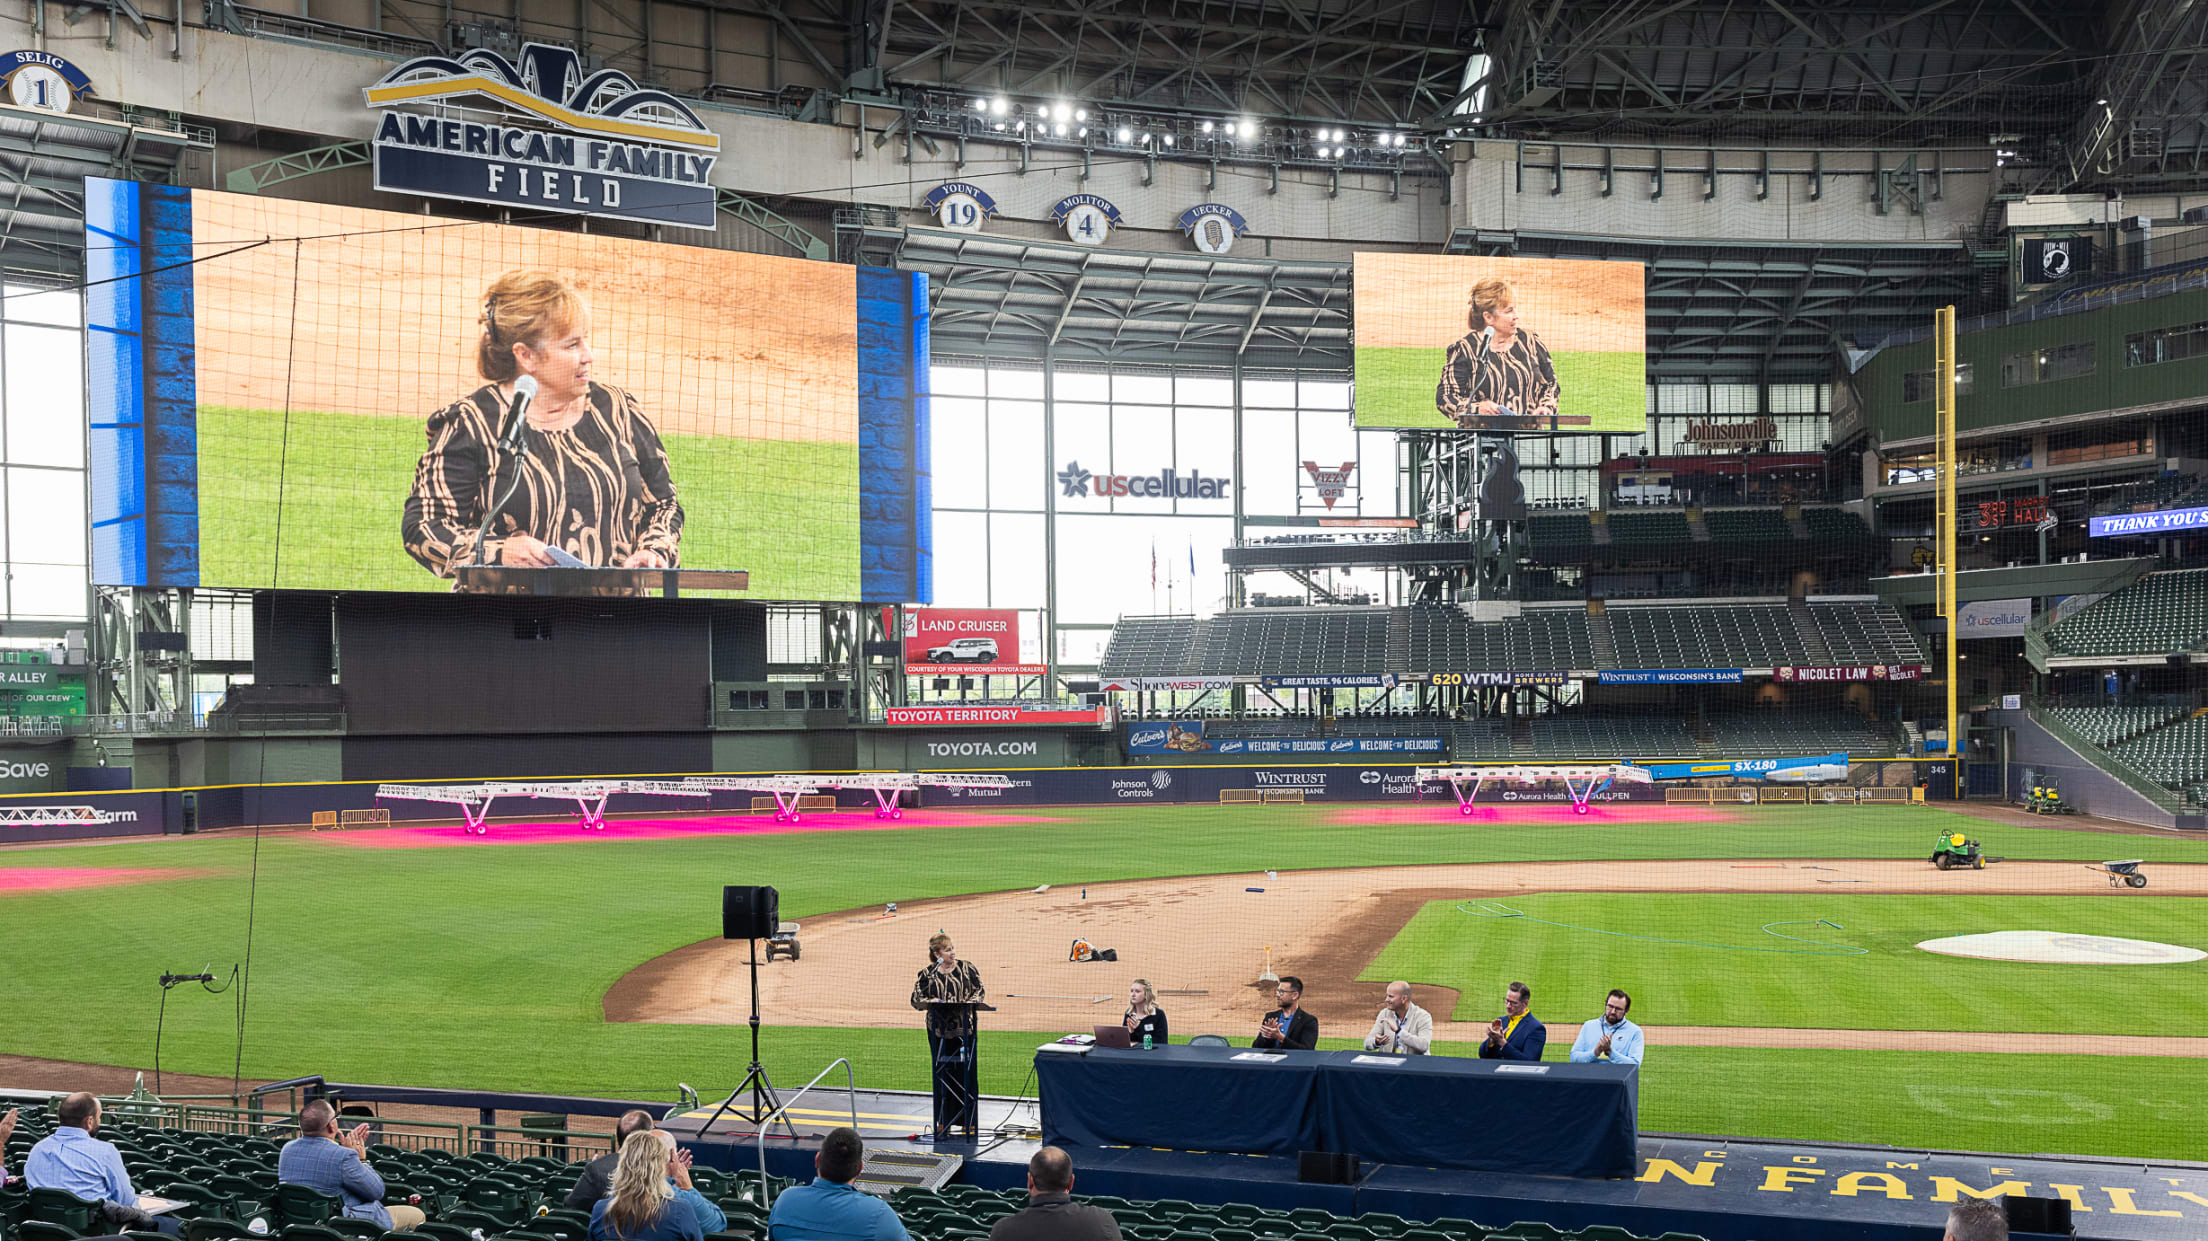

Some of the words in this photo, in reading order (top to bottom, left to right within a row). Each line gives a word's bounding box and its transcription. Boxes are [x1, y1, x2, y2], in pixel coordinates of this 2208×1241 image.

[15, 52, 64, 69] SELIG
[33, 79, 53, 110] 1
[375, 110, 576, 167] AMERICAN
[588, 142, 714, 185] FAMILY
[486, 163, 622, 208] FIELD
[942, 183, 980, 198] YOUNT
[1063, 196, 1112, 213] MOLITOR
[946, 202, 977, 227] 19
[1192, 205, 1232, 218] UECKER
[1078, 213, 1096, 238] 4
[1683, 417, 1777, 442] Johnsonville
[1701, 441, 1731, 449] PARTY
[1094, 468, 1231, 499] uscellular
[1311, 472, 1349, 483] VIZZY
[1319, 488, 1343, 497] LOFT
[2014, 507, 2050, 524] HALL
[2103, 515, 2159, 532] THANK
[2163, 512, 2198, 526] YOU
[1977, 613, 2026, 626] uscellular
[921, 620, 956, 632] LAND
[958, 620, 1008, 632] CRUISER
[1799, 668, 1843, 680] NICOLET
[1845, 667, 1869, 680] LAW
[1888, 665, 1901, 674] GET
[8, 672, 47, 683] ALLEY
[1281, 677, 1306, 686] GREAT
[1307, 677, 1331, 686] TASTE.
[1331, 676, 1342, 685] 96
[1343, 676, 1380, 685] CALORIES.
[1432, 673, 1462, 685] 620
[1463, 673, 1511, 685] WTMJ
[1600, 672, 1650, 682] WINTRUST
[1658, 672, 1714, 681] WISCONSIN'S
[1716, 672, 1740, 681] BANK
[46, 694, 71, 702] CREW
[890, 710, 943, 722] TOYOTA
[945, 709, 1018, 721] TERRITORY
[928, 742, 1037, 756] TOYOTA.COM
[1247, 741, 1281, 751] WELCOME
[1292, 741, 1326, 751] DELICIOUS
[1359, 740, 1393, 751] WELCOME
[1404, 740, 1438, 750] DELICIOUS
[0, 760, 49, 778] Save
[1734, 760, 1777, 772] SX-180
[1930, 766, 1946, 774] 345
[1255, 771, 1327, 784] WINTRUST
[1382, 773, 1417, 783] Aurora
[1112, 779, 1147, 790] Johnson
[1382, 783, 1416, 793] Health
[1420, 783, 1443, 793] Care
[968, 788, 1001, 797] Mutual
[1118, 789, 1154, 798] Controls
[1518, 792, 1542, 801] Aurora
[1543, 791, 1567, 800] Health
